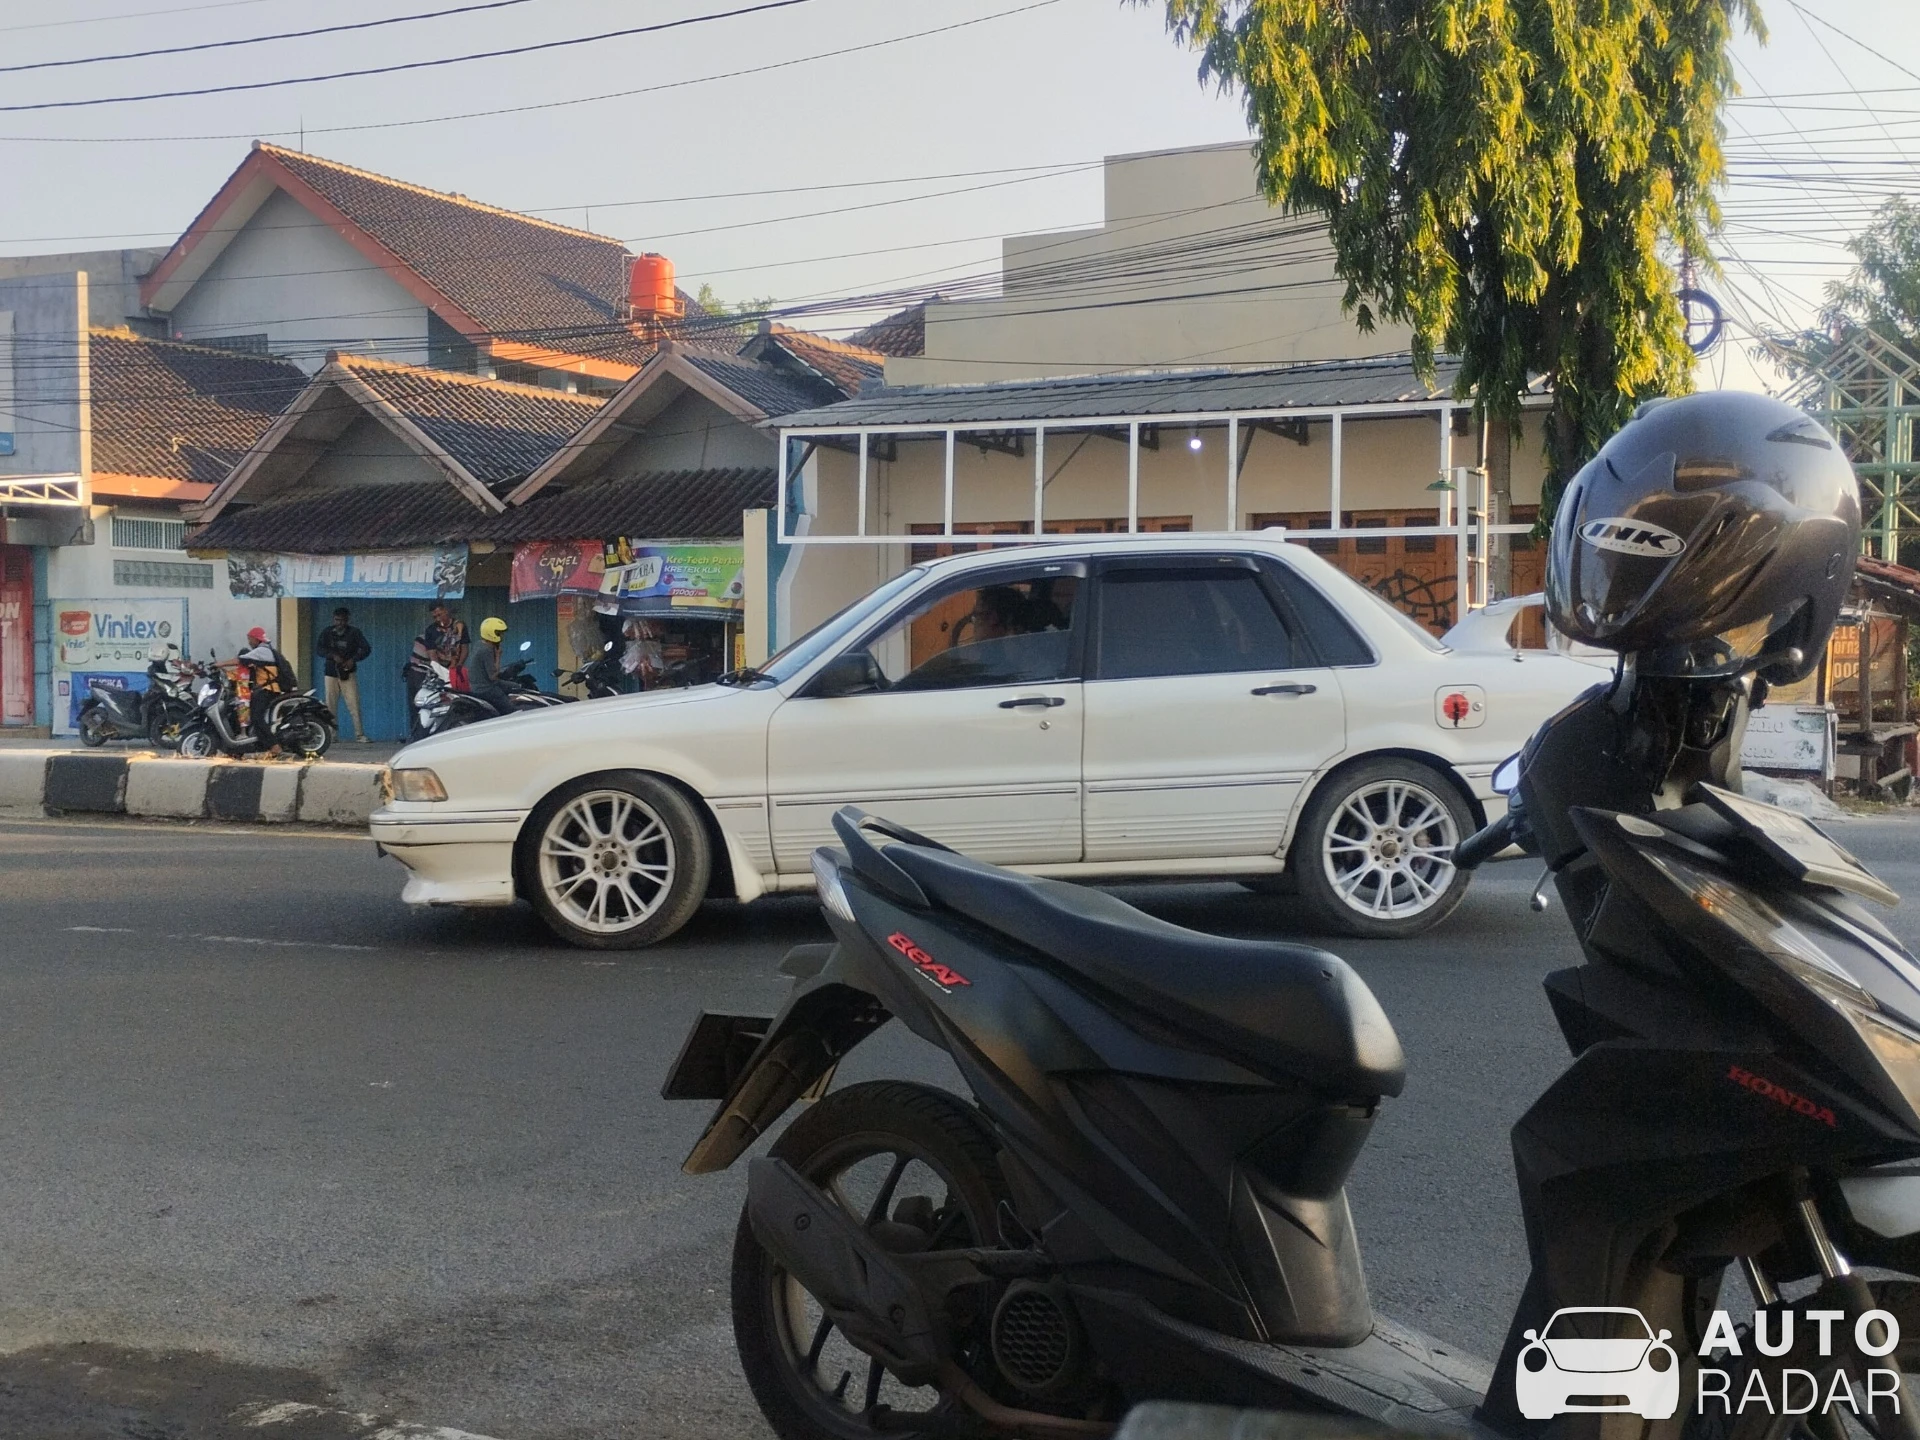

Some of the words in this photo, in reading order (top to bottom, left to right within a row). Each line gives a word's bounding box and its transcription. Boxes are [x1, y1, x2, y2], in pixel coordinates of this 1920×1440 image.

[1587, 523, 1676, 550] INK
[352, 556, 435, 583] MOTOR
[539, 556, 578, 567] CAMEL
[94, 614, 157, 639] Vinilex
[1726, 1065, 1838, 1128] HONDA
